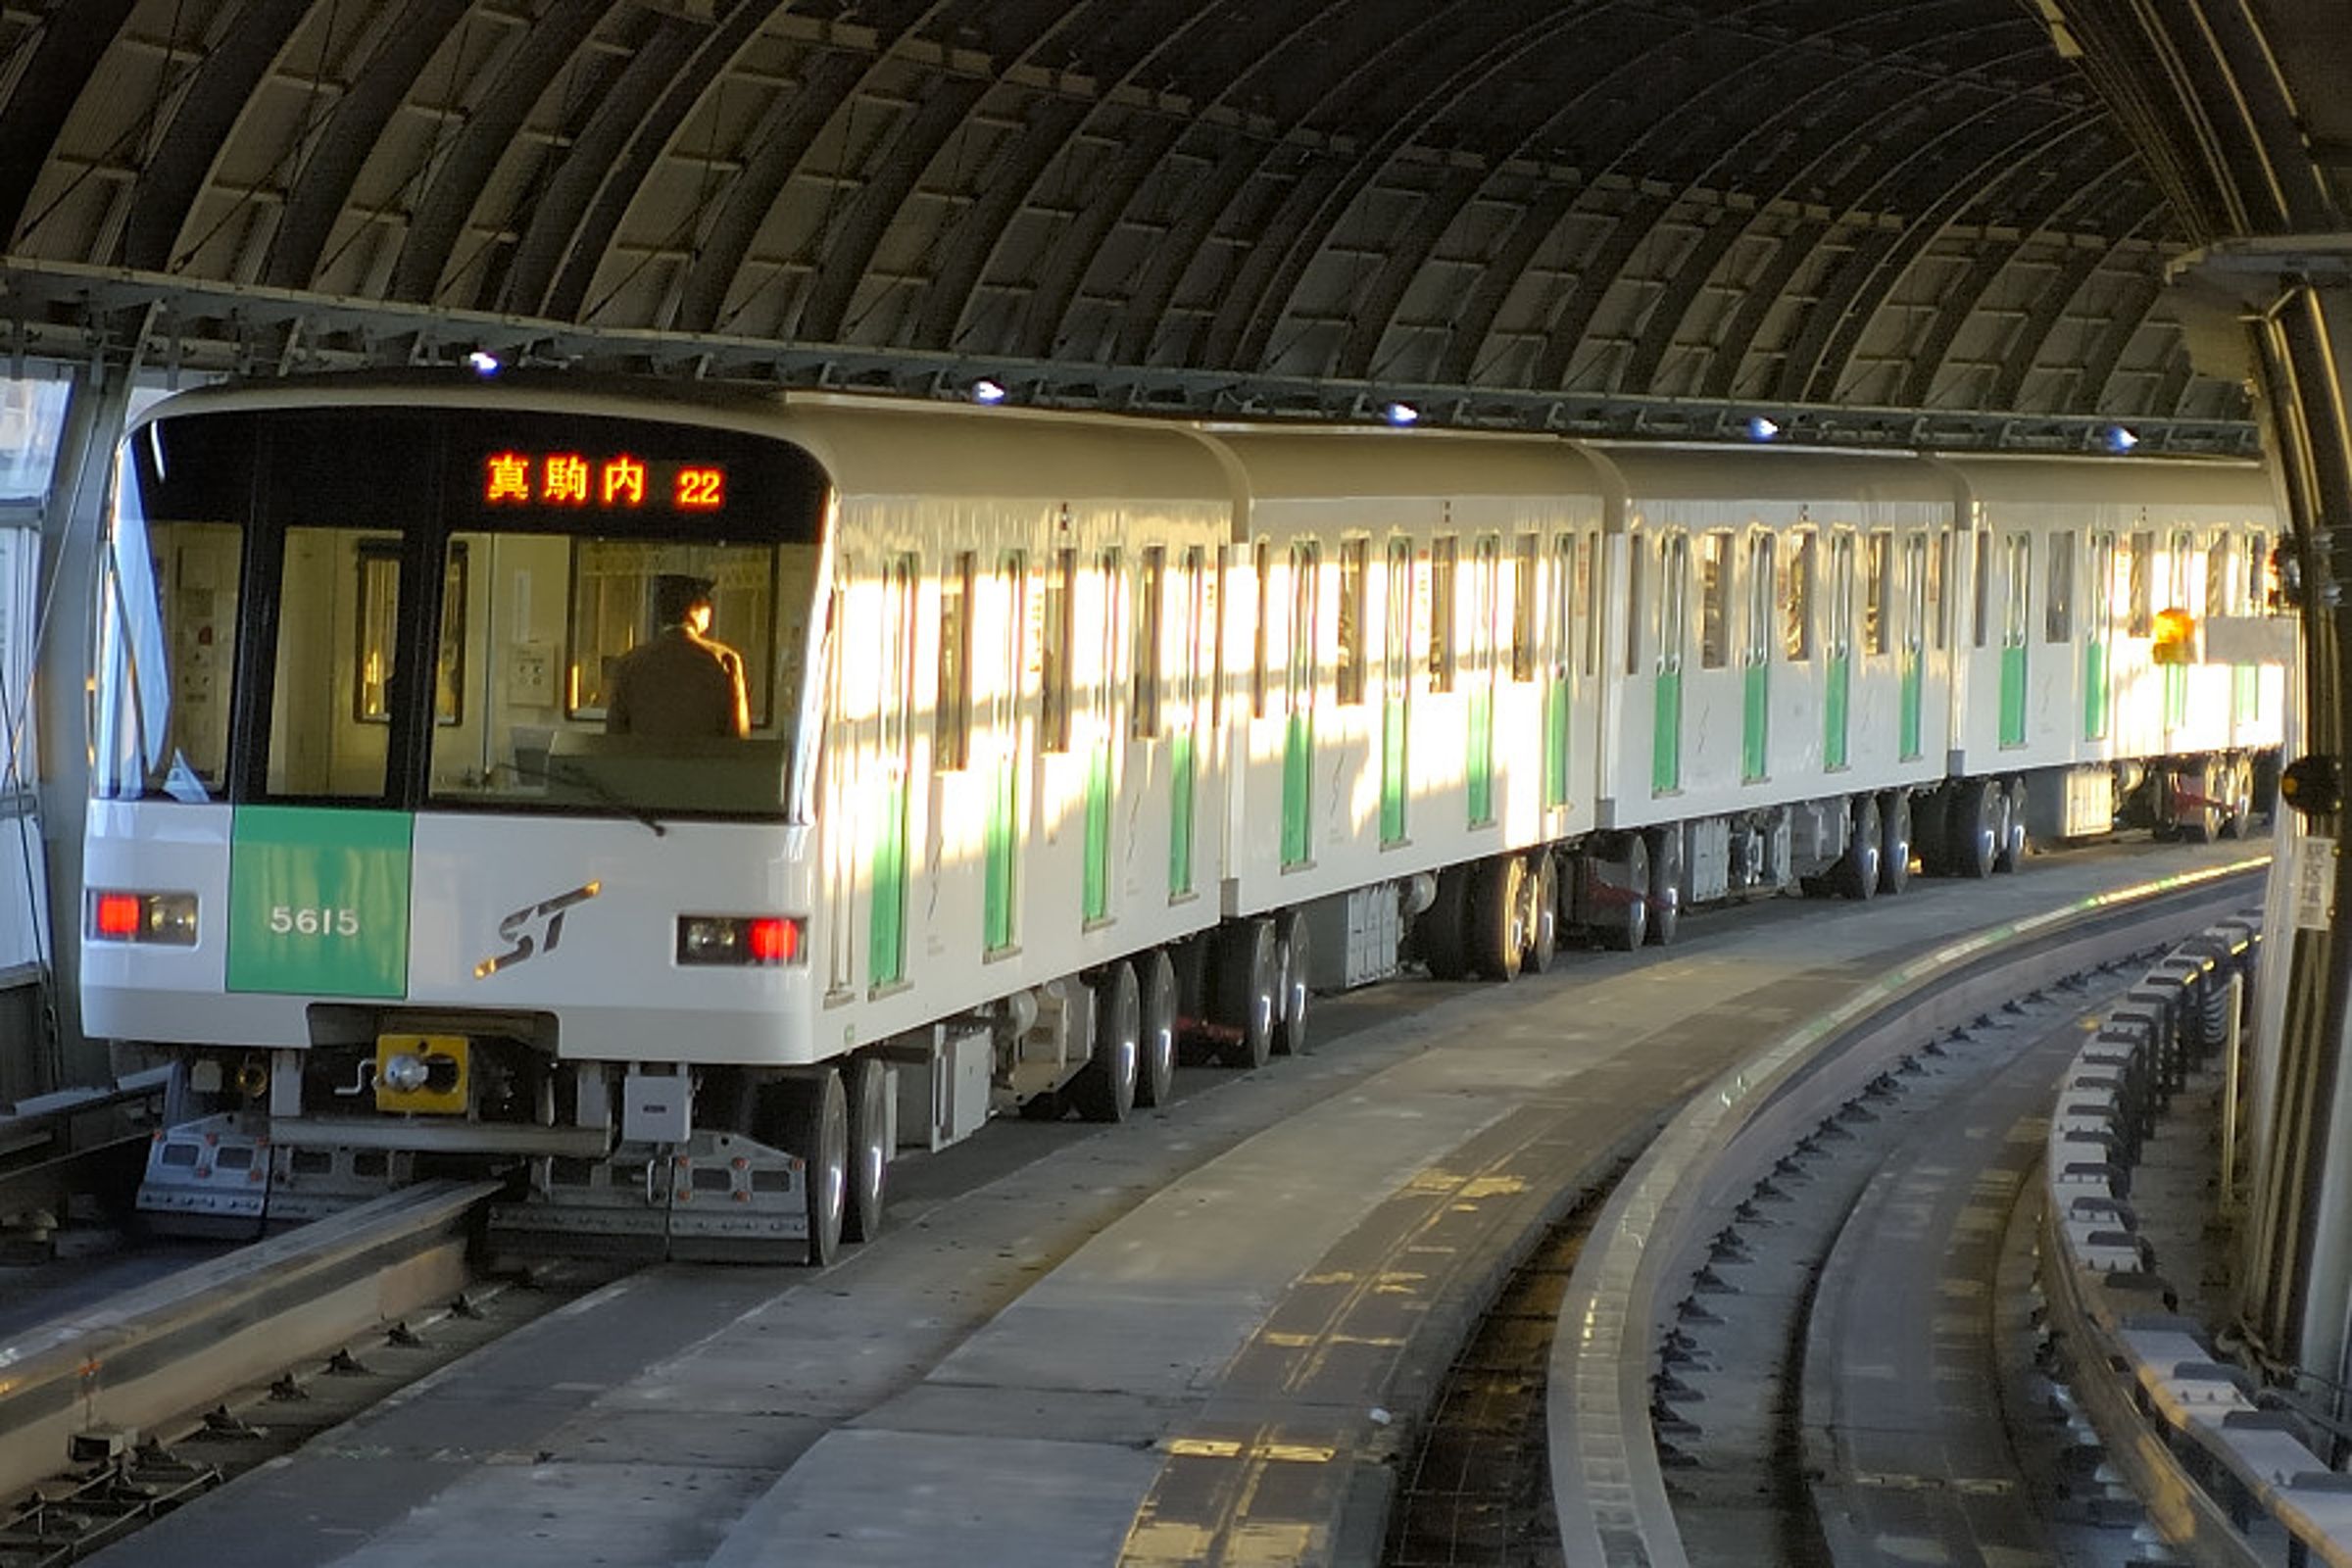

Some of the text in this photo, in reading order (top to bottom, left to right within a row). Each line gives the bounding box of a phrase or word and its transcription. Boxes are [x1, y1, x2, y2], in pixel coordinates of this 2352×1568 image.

[487, 453, 722, 505] 真駒内 22
[270, 906, 360, 937] 5615
